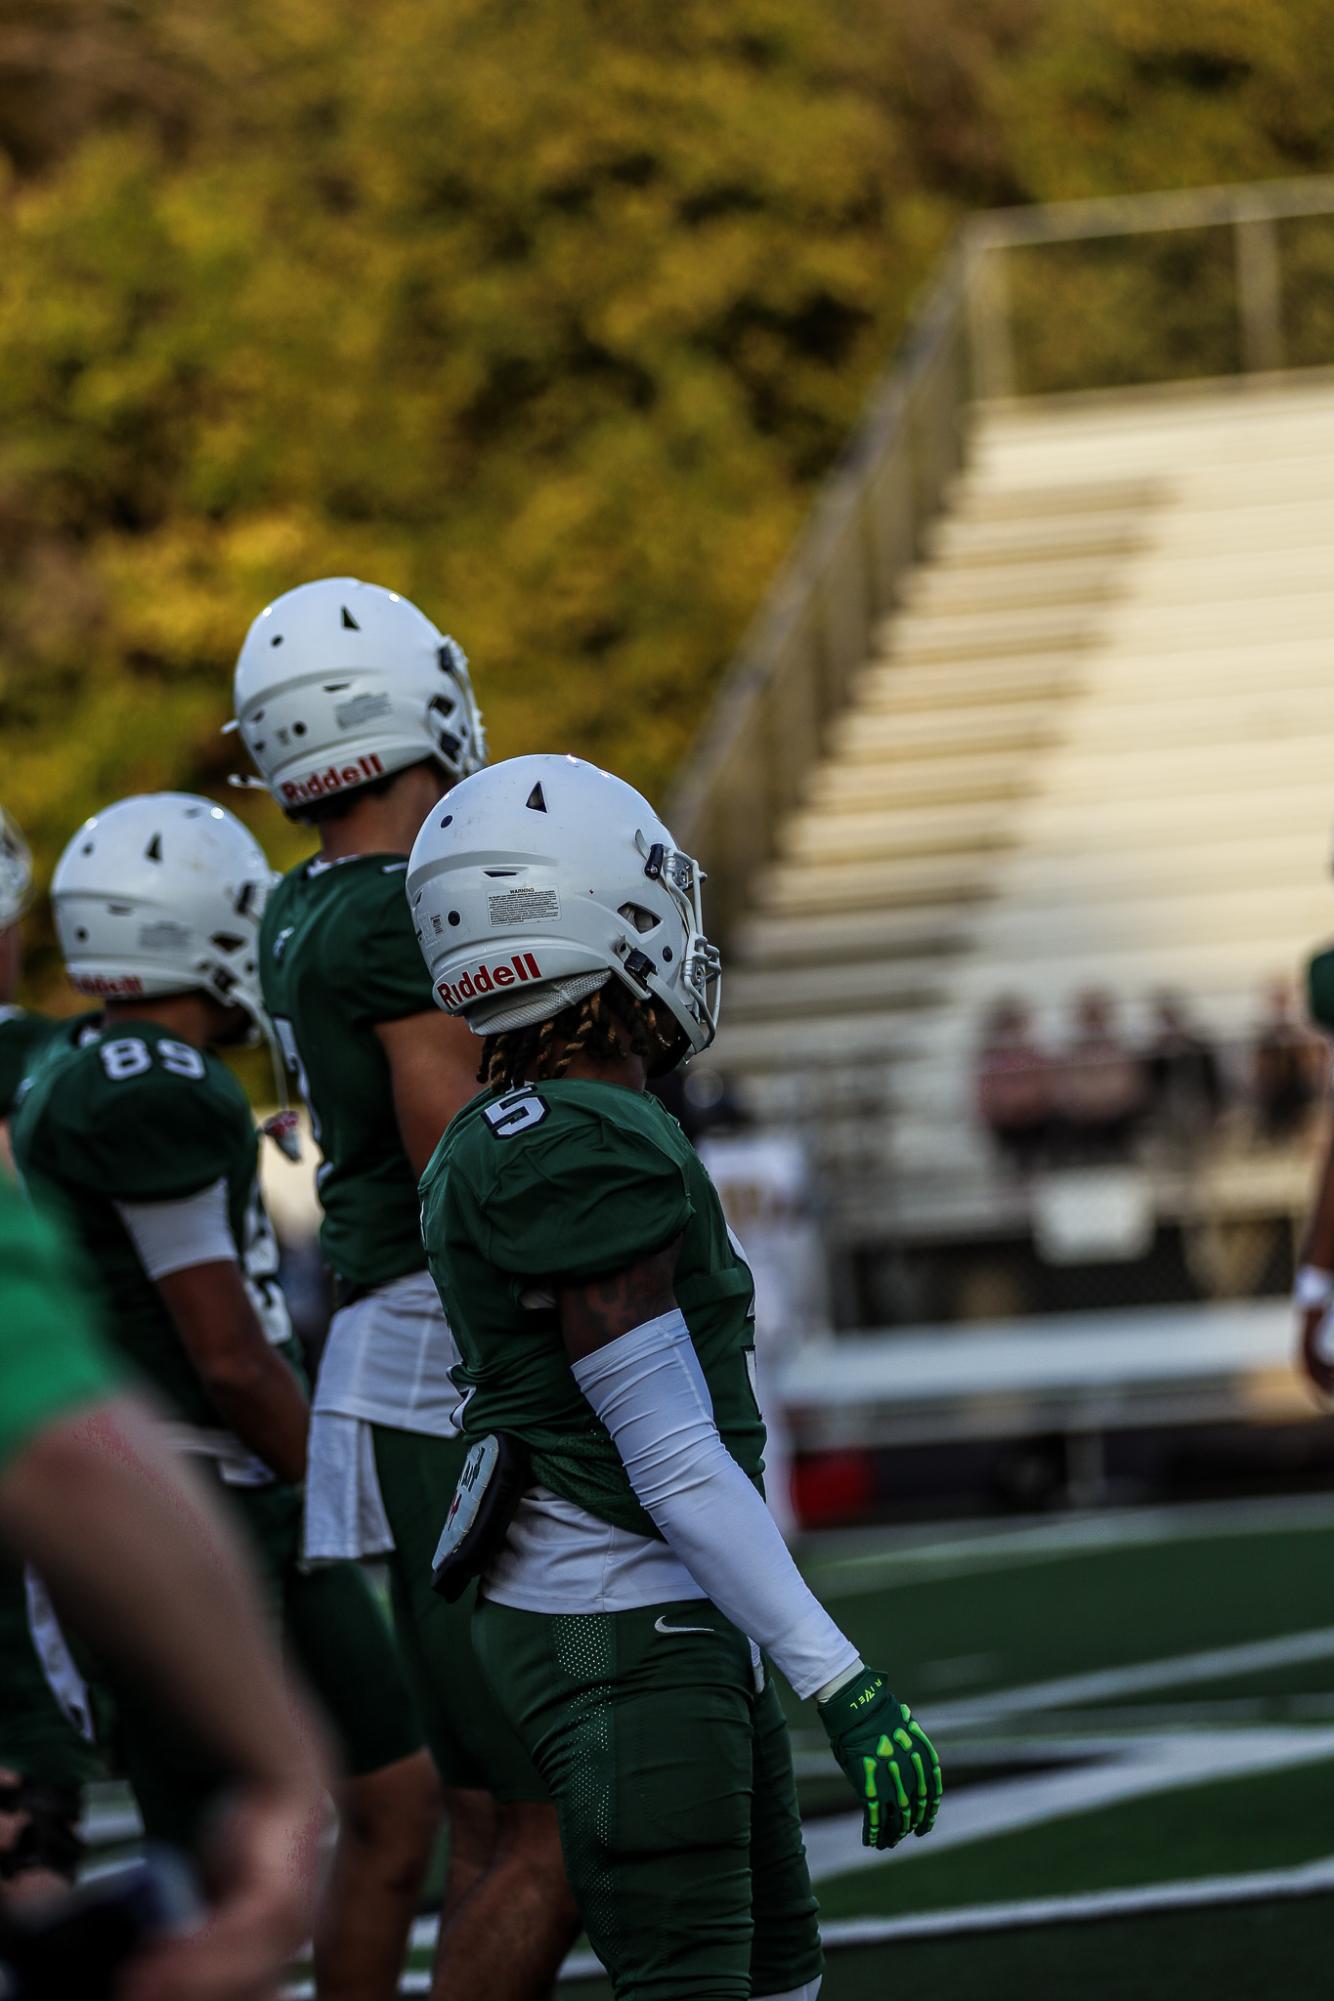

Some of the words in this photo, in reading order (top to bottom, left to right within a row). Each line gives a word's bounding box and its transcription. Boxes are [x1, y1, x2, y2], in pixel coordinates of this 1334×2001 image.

[281, 754, 383, 802] Riddell
[437, 954, 542, 1010] Riddell
[101, 1037, 206, 1081] 89
[482, 1086, 549, 1137] 5
